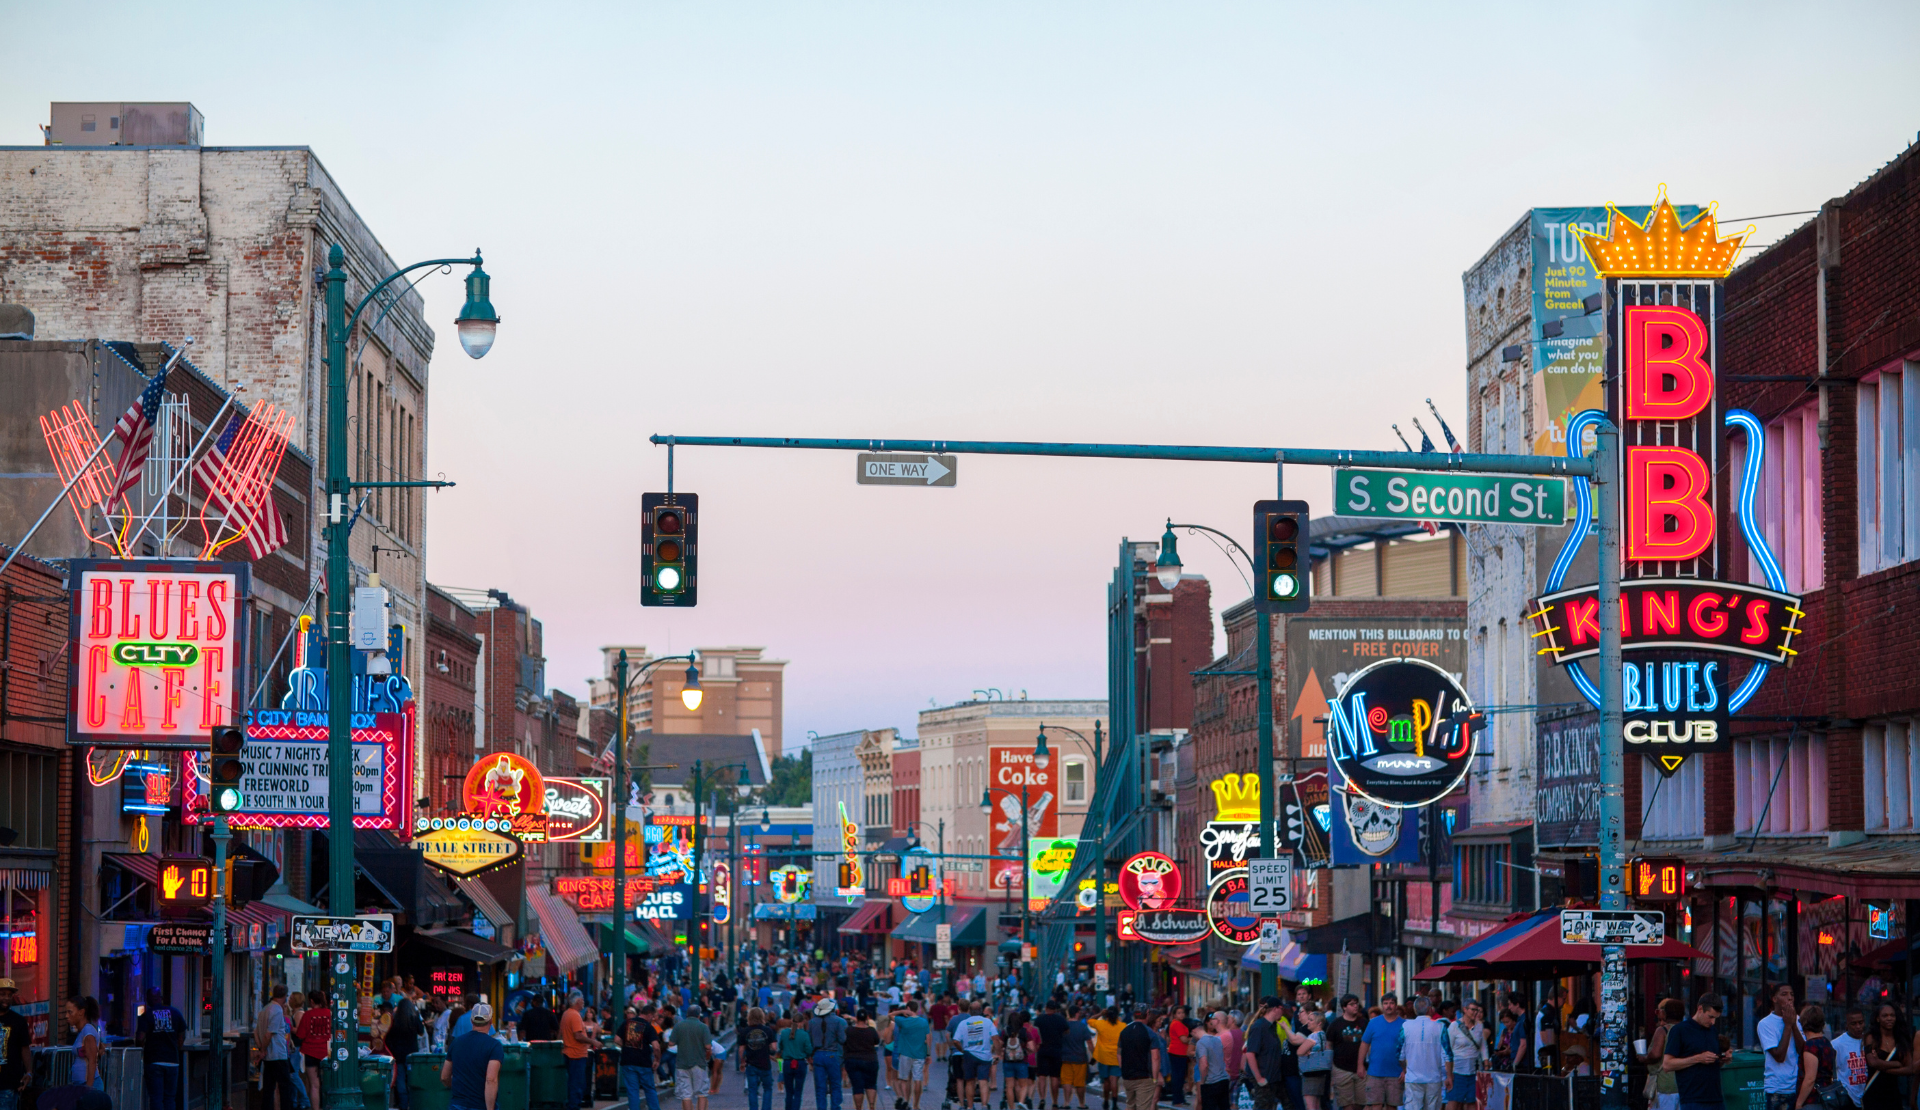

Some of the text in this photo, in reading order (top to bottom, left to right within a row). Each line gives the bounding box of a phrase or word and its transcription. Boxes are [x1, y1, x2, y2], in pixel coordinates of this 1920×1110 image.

[1544, 266, 1586, 277] Just 90
[1545, 278, 1588, 288] Minutes
[1544, 288, 1571, 299] from
[1547, 349, 1599, 363] what you
[1625, 305, 1715, 420] B
[1547, 364, 1569, 374] can
[1570, 363, 1586, 374] do
[869, 463, 928, 477] ONE WAY
[1348, 475, 1554, 520] S. Second St.
[1626, 446, 1716, 561] B
[88, 578, 227, 640] BLUES
[1565, 590, 1771, 646] KING'S
[1308, 628, 1357, 641] MENTION
[1359, 628, 1385, 641] THIS
[1387, 628, 1444, 641] BILLBOARD
[1446, 629, 1461, 641] TO
[119, 645, 194, 664] CITY
[1353, 642, 1440, 657] FREE COVER
[87, 645, 224, 729] CAFE
[1621, 660, 1718, 712] BLUES
[257, 711, 292, 727] CITY
[295, 712, 330, 728] BAN
[351, 712, 377, 729] OX
[1622, 719, 1719, 744] CLUB
[240, 747, 273, 761] MUSIC
[275, 747, 281, 761] 7
[284, 746, 322, 762] NIGHTS
[1000, 750, 1034, 764] Have
[258, 762, 309, 778] CUNNING
[312, 763, 329, 778] TRI
[998, 766, 1049, 786] Coke
[244, 778, 310, 793] FREEWORLD
[1306, 783, 1329, 793] BLA
[253, 794, 284, 809] SOUTH
[286, 795, 298, 809] IN
[299, 795, 325, 810] YOUR
[544, 788, 593, 818] Sweets
[516, 832, 545, 842] CAFE
[417, 841, 512, 854] BEALE STREET
[598, 856, 637, 868] ROM
[1127, 857, 1173, 876] PIG
[1213, 860, 1248, 869] HALL OF
[1252, 864, 1287, 874] SPEED
[191, 867, 207, 898] 10
[557, 878, 654, 893] KING'S PAACE
[1256, 876, 1283, 885] LIMIT
[1662, 866, 1676, 894] 10
[1253, 887, 1287, 906] 25
[1030, 900, 1046, 910] FOO
[1152, 912, 1209, 930] Schwab
[153, 926, 174, 936] First
[175, 927, 207, 937] Chance
[156, 936, 170, 945] For
[170, 936, 177, 945] A
[179, 936, 204, 946] Drink
